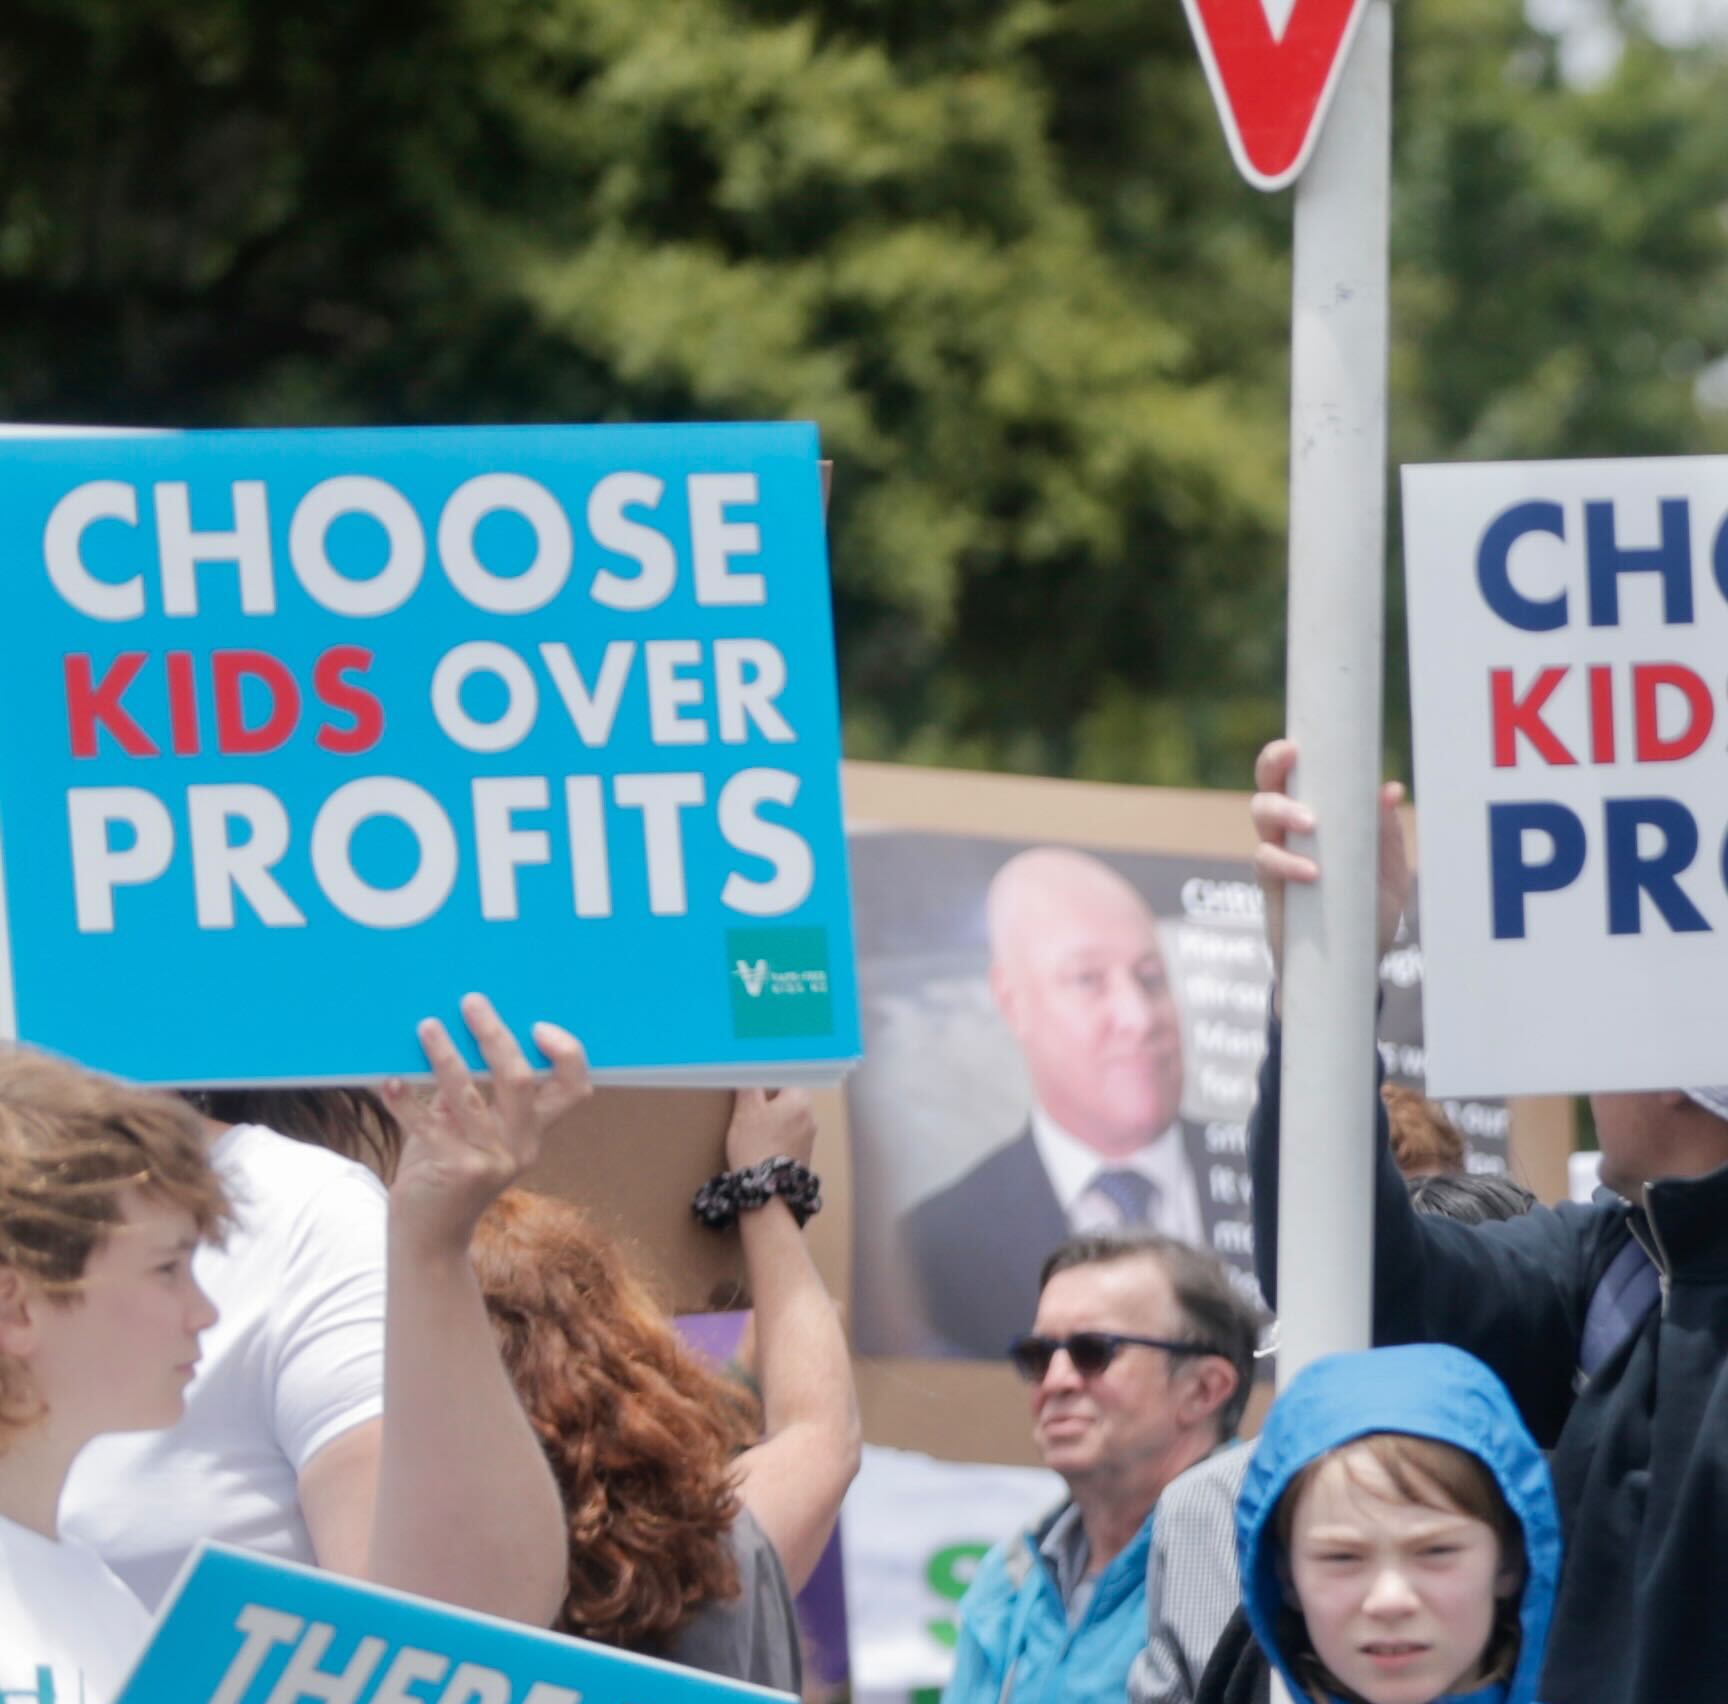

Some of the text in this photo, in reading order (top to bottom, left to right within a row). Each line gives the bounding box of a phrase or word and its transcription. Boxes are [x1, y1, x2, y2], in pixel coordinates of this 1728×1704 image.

[45, 473, 766, 621] CHOOSE
[64, 638, 797, 758] KIDS OVER
[67, 766, 814, 932] PROFITS
